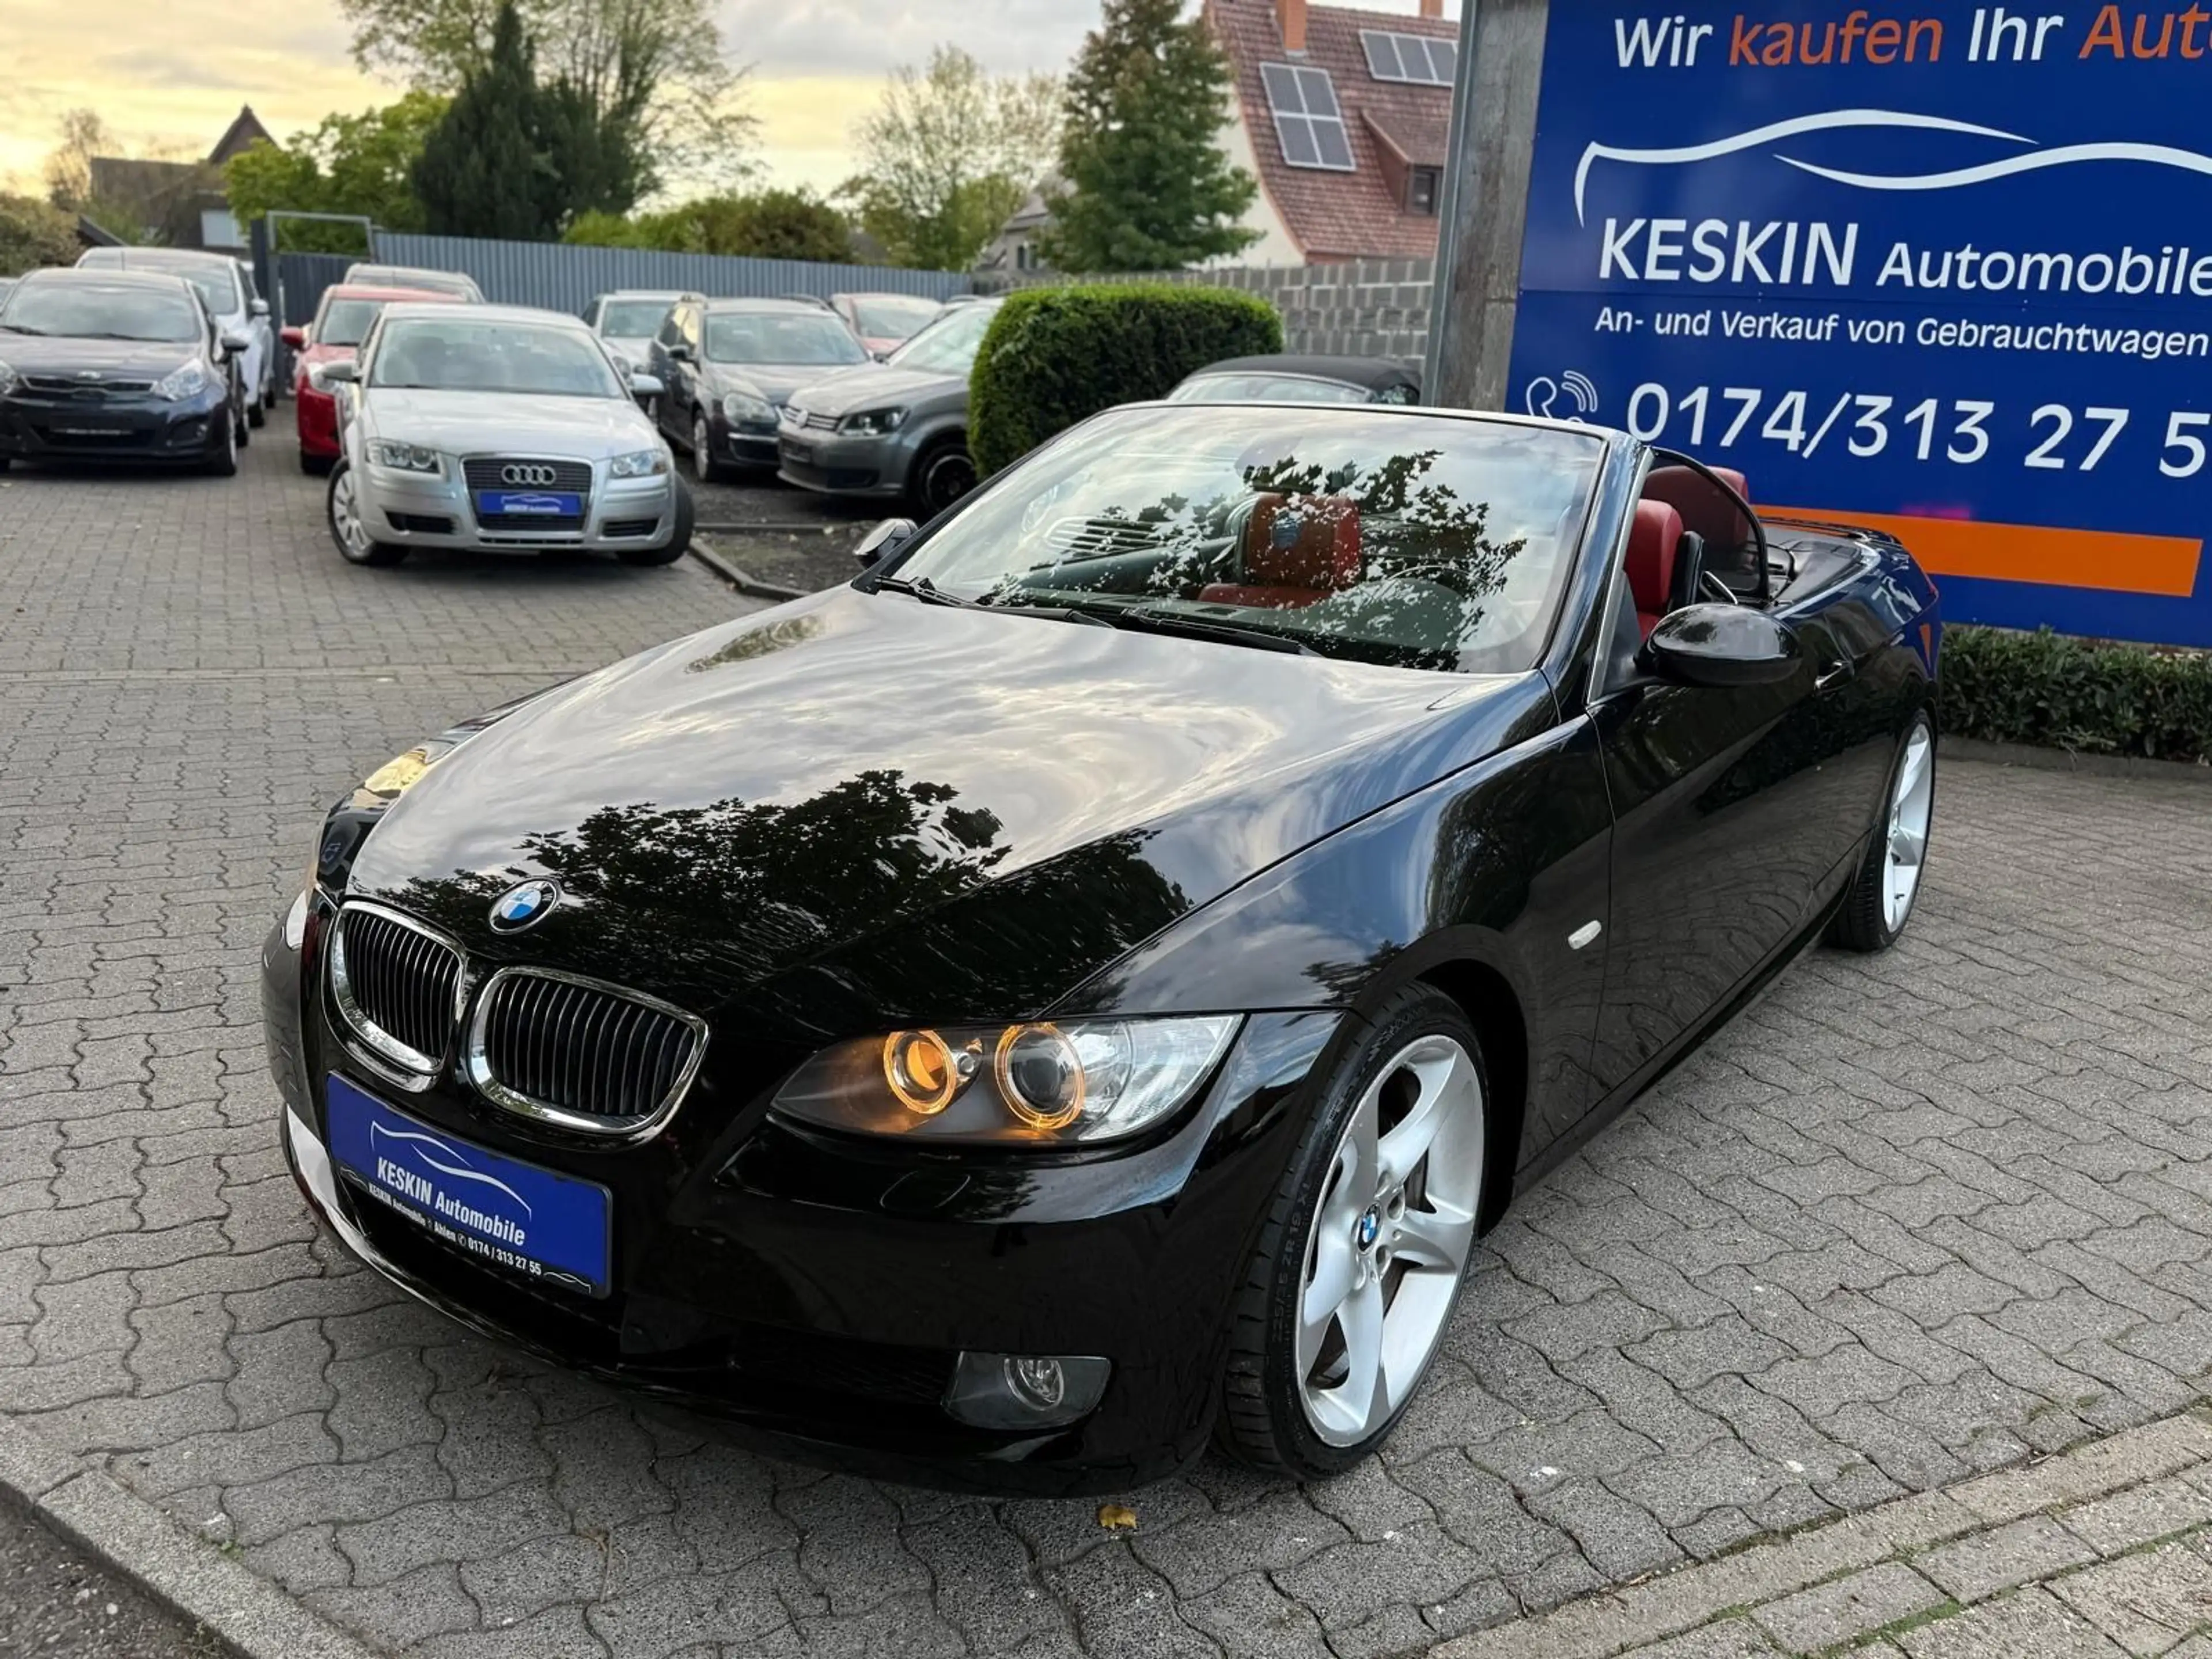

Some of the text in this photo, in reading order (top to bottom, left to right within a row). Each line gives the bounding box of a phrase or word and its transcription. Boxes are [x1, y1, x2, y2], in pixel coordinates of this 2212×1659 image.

[1615, 2, 2212, 67] Wir kaufen Ihr Aut
[1599, 218, 2212, 297] KESKIN Automobile
[1594, 307, 2209, 360] An- und Verkauf von Gebrauchtwagen
[1626, 382, 1995, 464] 0174/313
[2024, 404, 2130, 472] 27
[377, 1156, 526, 1247] KESKIN Automobile
[468, 1237, 490, 1256] 0174
[496, 1248, 514, 1266] 313
[516, 1255, 527, 1270] 27
[529, 1260, 542, 1276] 55
